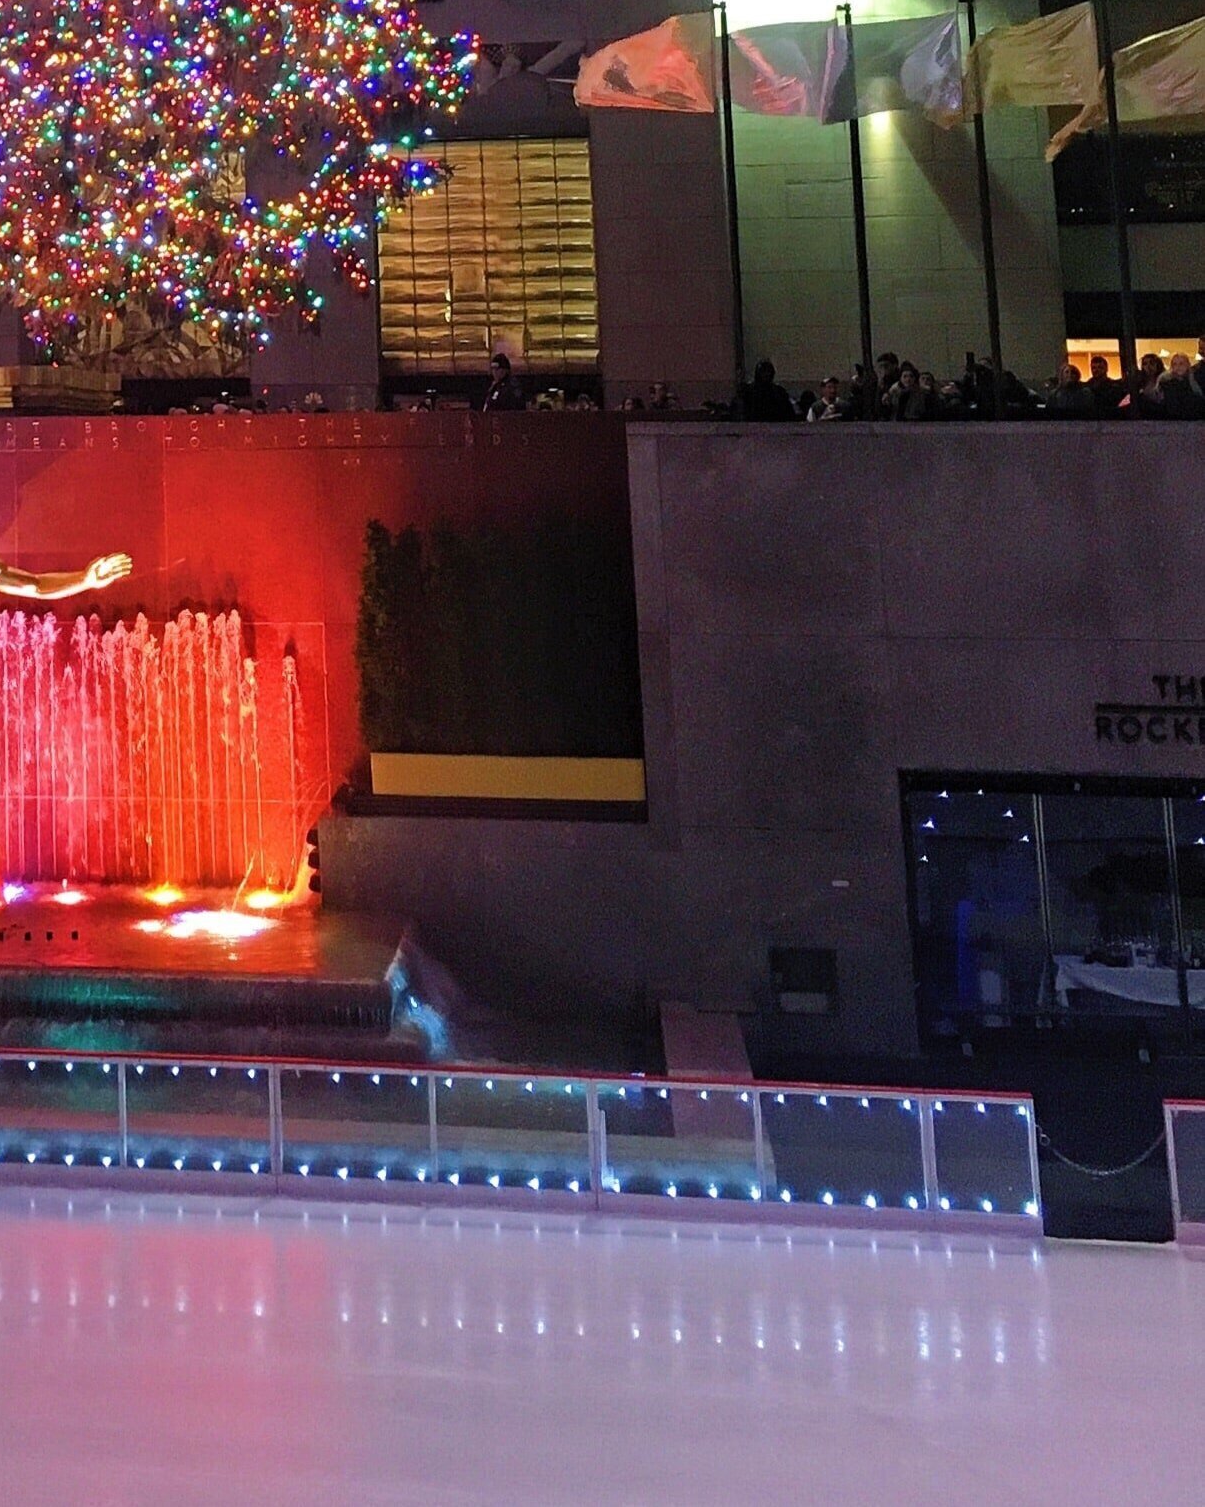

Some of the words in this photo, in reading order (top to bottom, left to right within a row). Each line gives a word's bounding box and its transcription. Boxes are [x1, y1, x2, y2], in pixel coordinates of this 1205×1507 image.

[299, 418, 361, 430] THE
[165, 435, 200, 447] TO
[245, 435, 391, 446] MIGHTY
